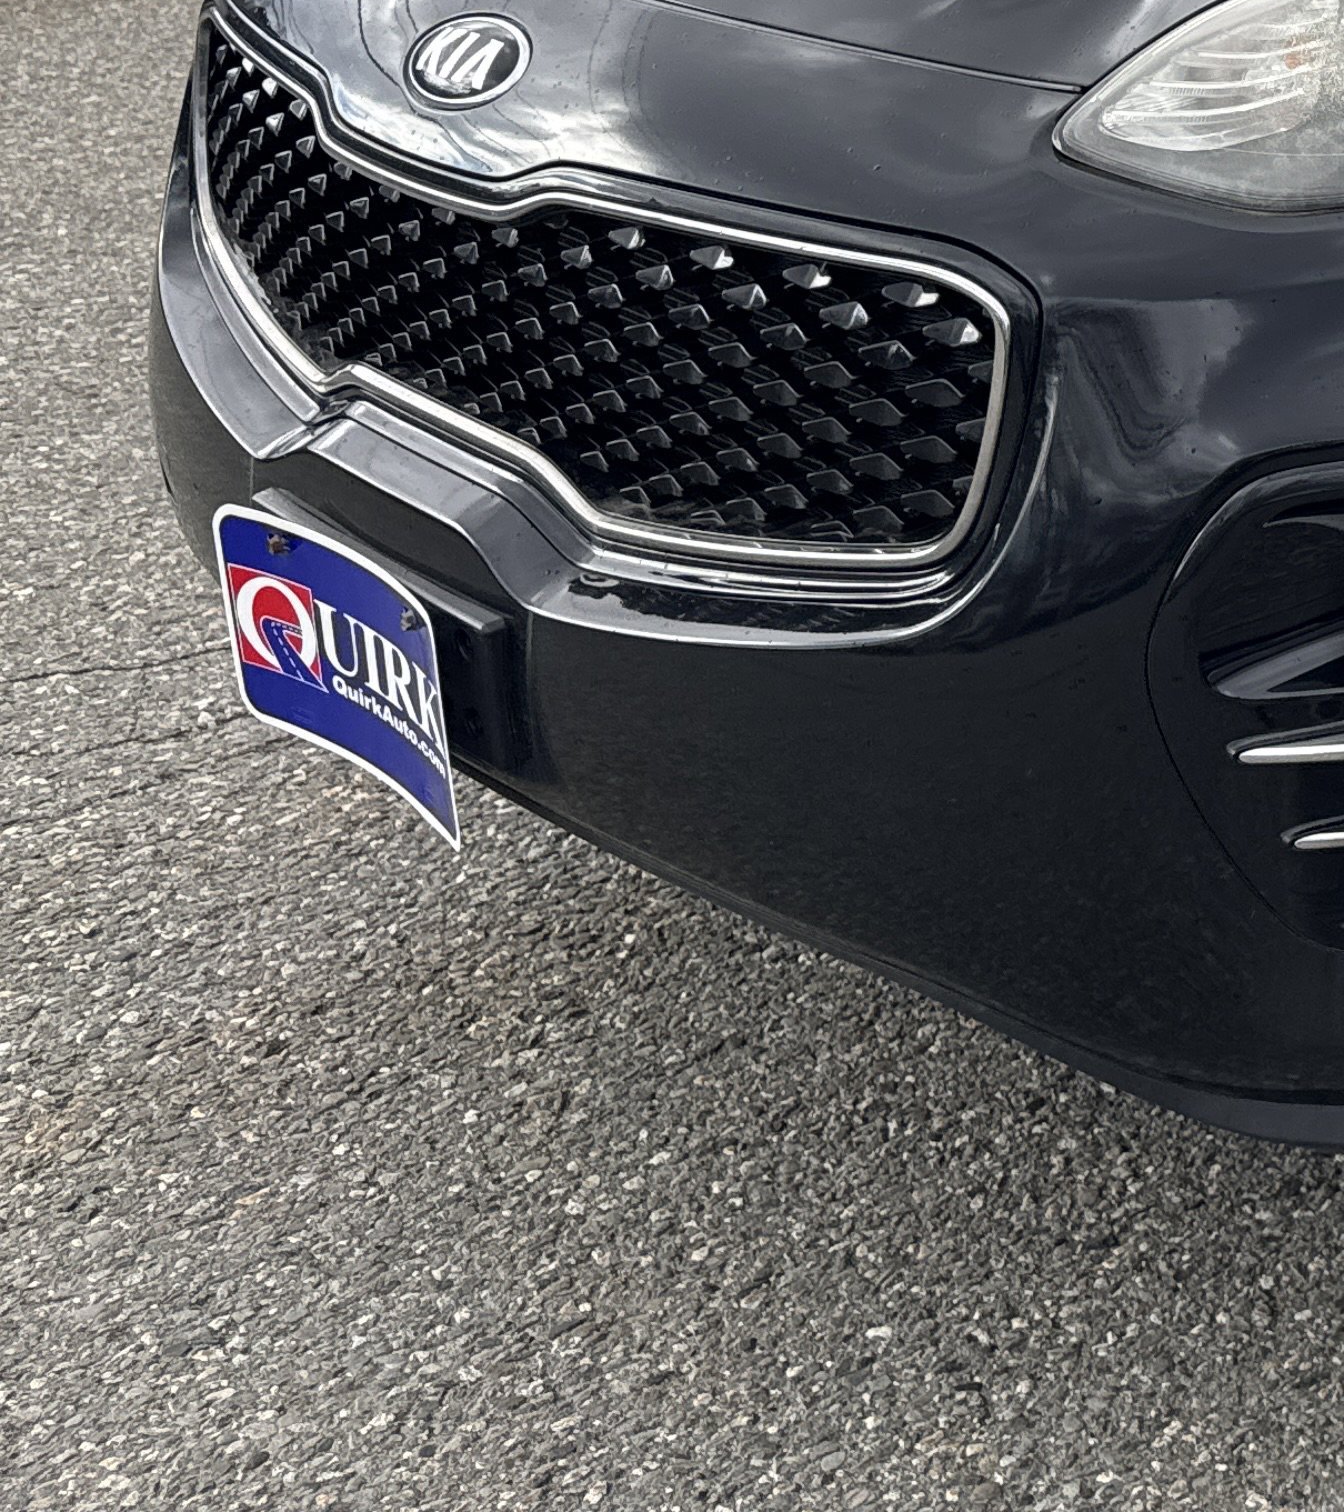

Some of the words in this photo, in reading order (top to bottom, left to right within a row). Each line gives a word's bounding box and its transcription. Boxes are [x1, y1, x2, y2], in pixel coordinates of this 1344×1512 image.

[415, 26, 505, 91] KIA
[236, 576, 447, 759] QUIRK
[331, 674, 447, 779] QuirkAuto.com
